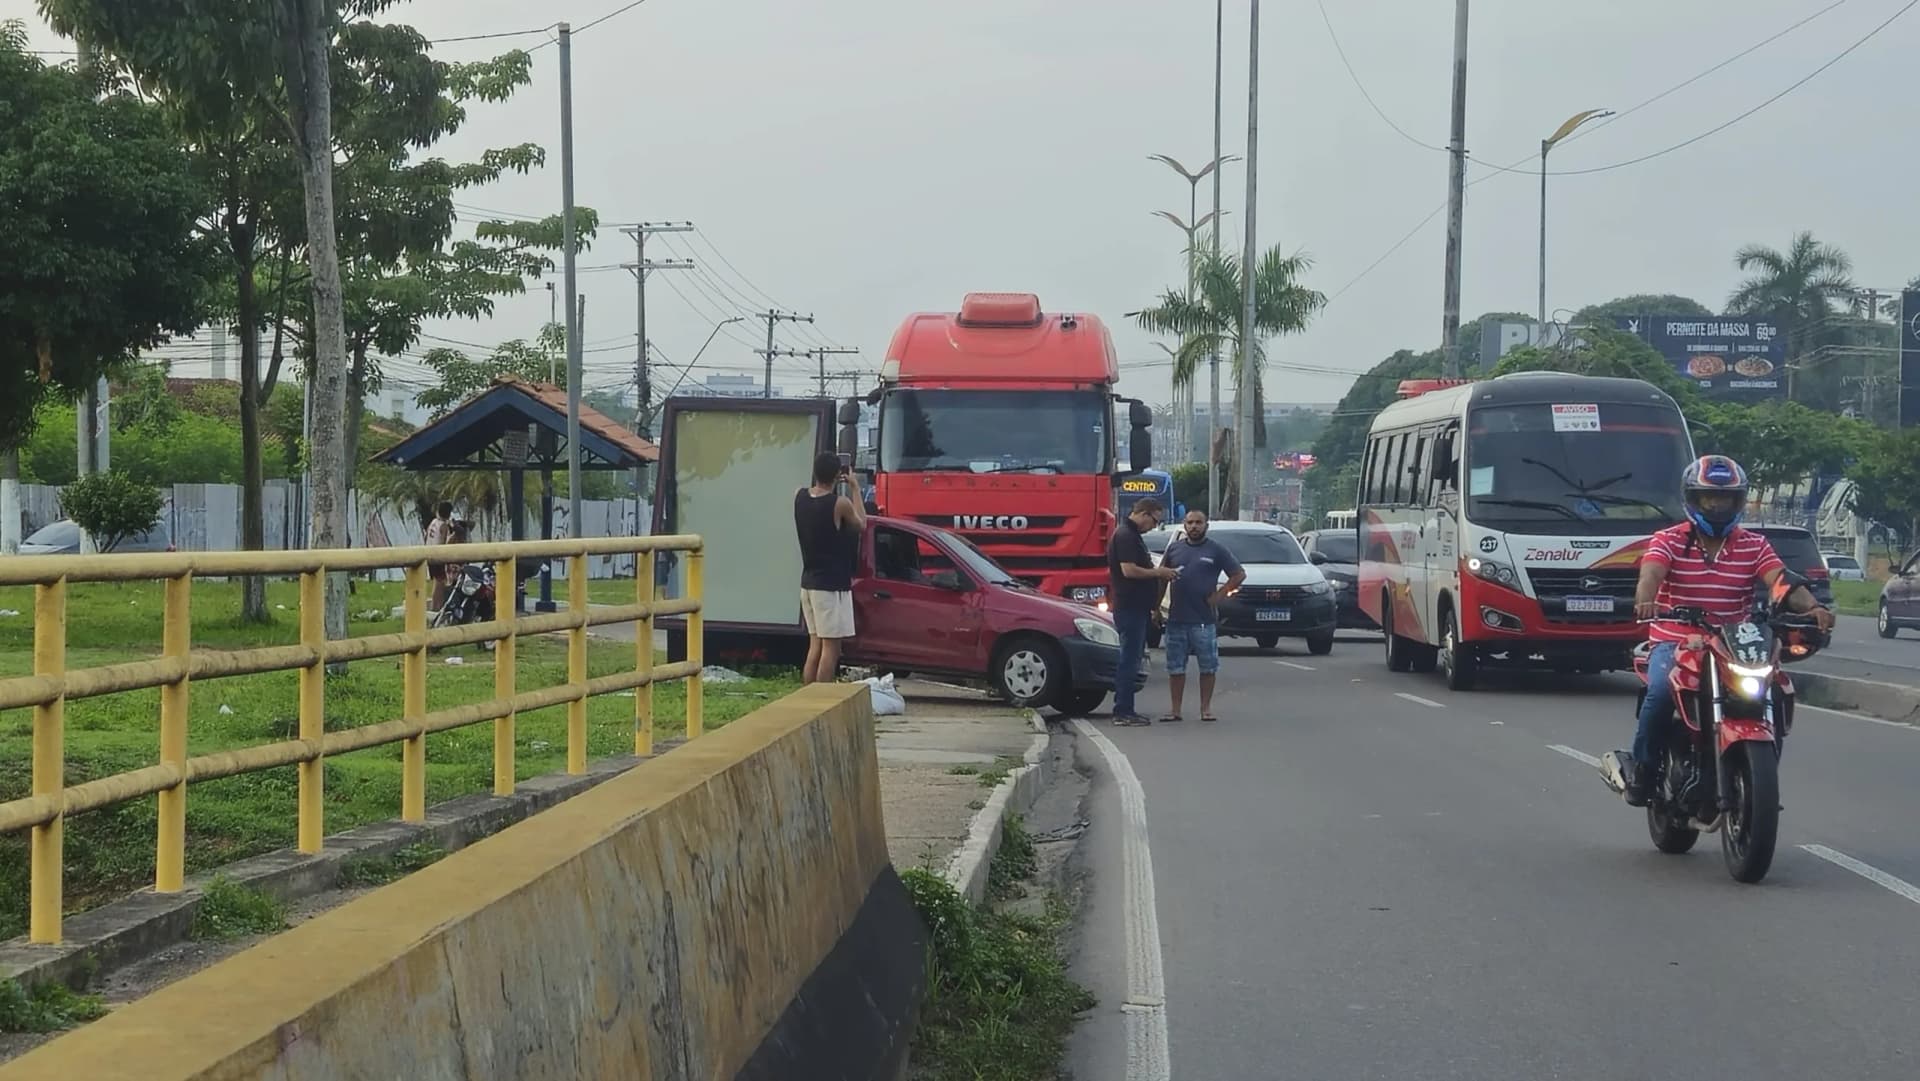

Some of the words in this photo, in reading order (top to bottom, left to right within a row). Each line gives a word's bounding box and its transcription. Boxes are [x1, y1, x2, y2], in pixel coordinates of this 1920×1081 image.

[1666, 322, 1706, 336] PERNOITE
[1707, 322, 1719, 336] DA
[1720, 322, 1750, 336] MASSA
[1123, 481, 1156, 492] CENTRO
[953, 515, 1029, 530] IVECO
[1481, 540, 1497, 550] 237
[1524, 548, 1583, 561] Zenatur
